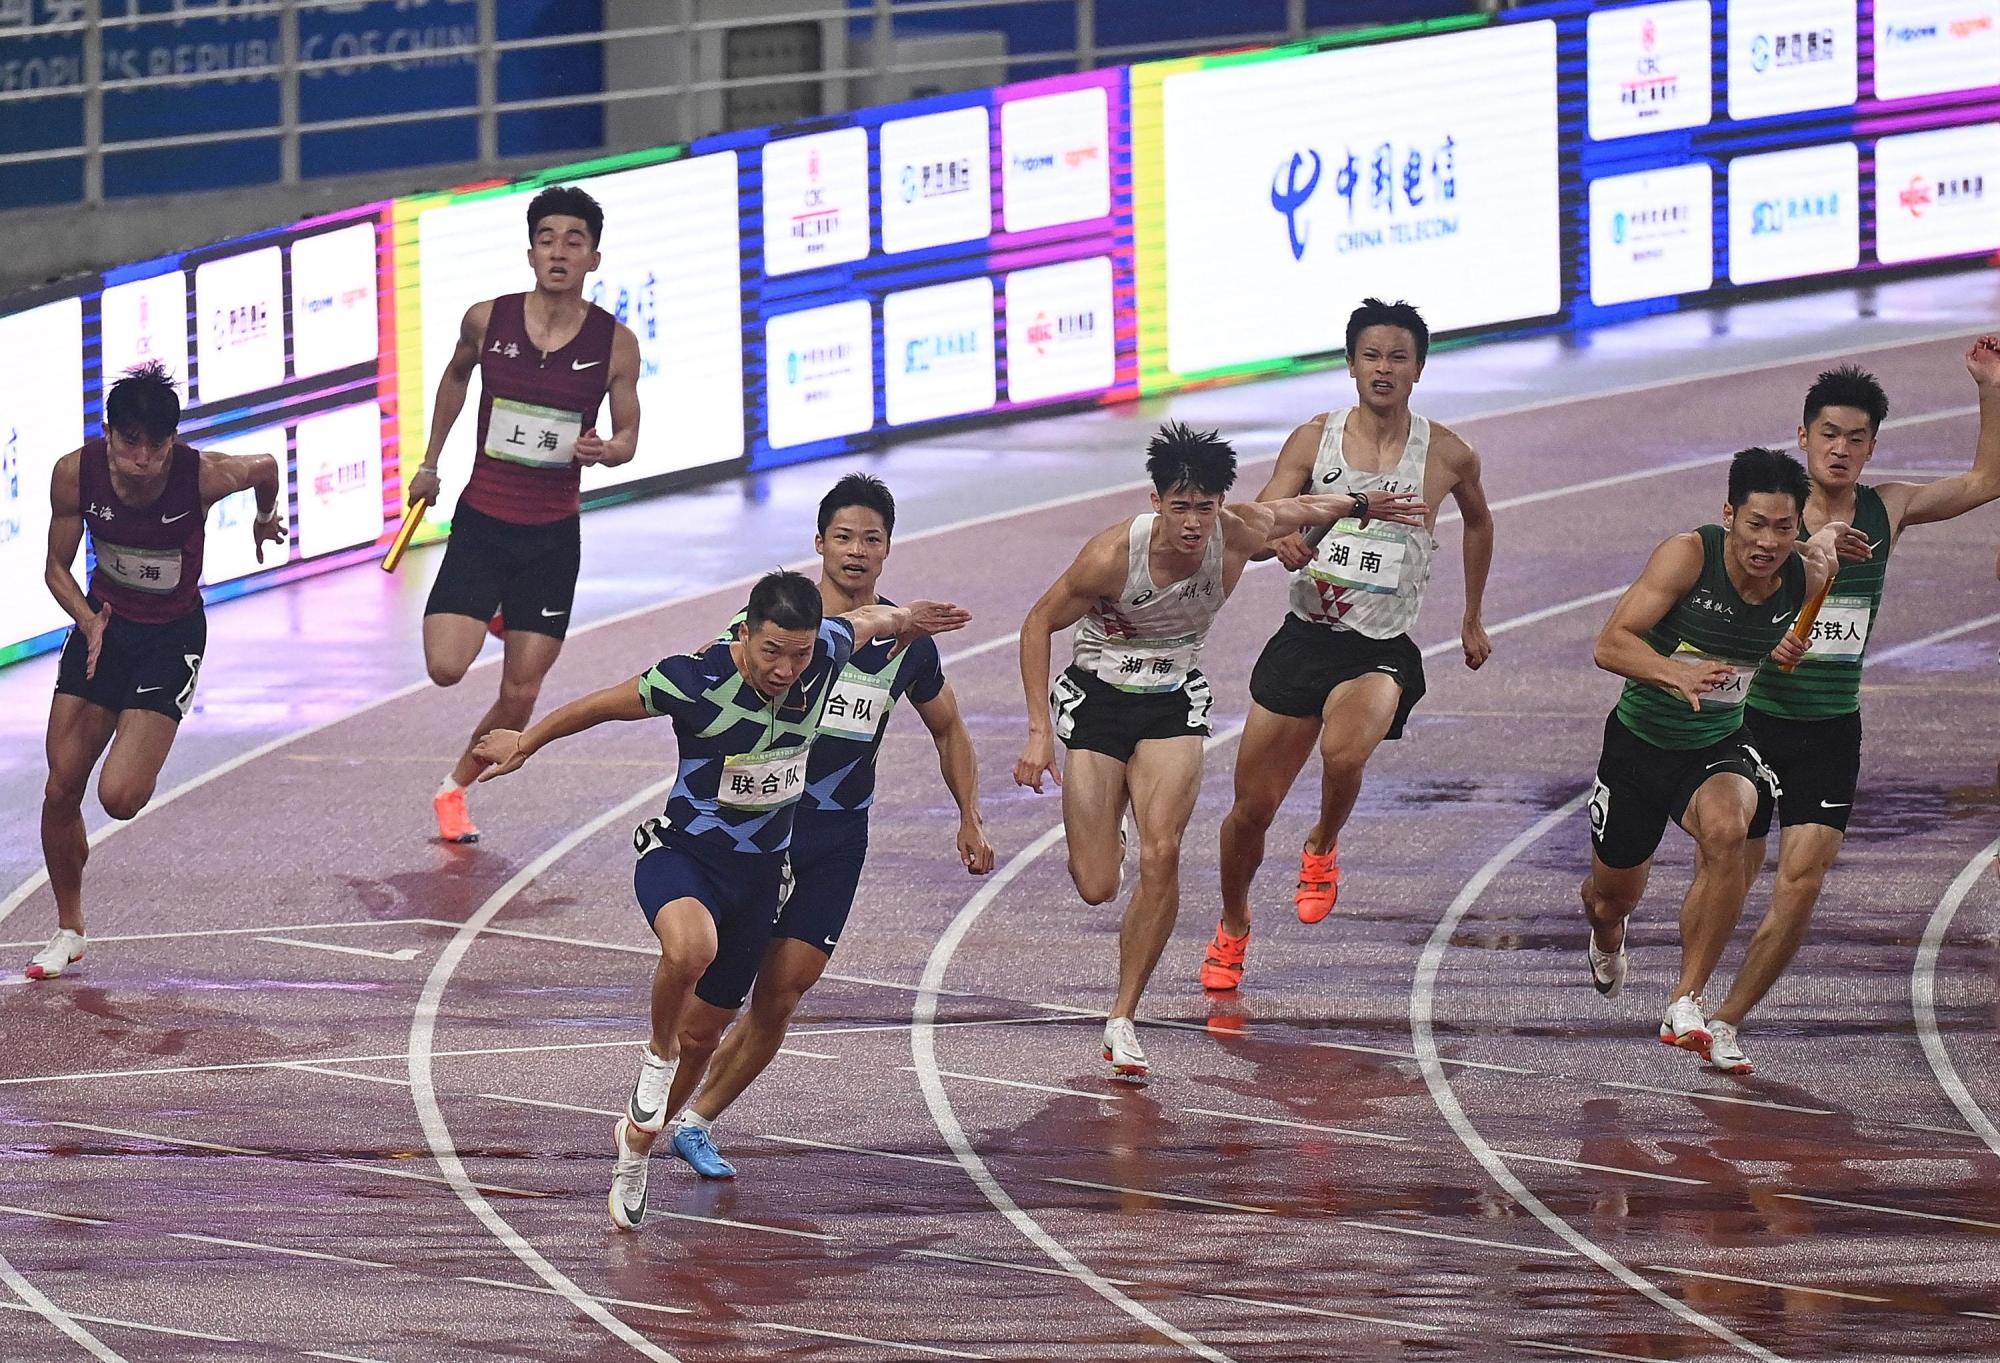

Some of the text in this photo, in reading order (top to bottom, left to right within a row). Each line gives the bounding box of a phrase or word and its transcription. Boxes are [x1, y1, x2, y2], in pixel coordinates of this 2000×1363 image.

[331, 29, 381, 76] OF
[1336, 135, 1456, 221] 中国电信
[1335, 230, 1384, 254] CHINA
[505, 424, 560, 451] 上海
[86, 502, 115, 522] 上海
[110, 558, 161, 582] 上海
[1328, 541, 1383, 574] 湖南
[1807, 620, 1861, 641] 苏铁人
[1119, 655, 1175, 675] 湖南
[730, 764, 800, 795] 联合队
